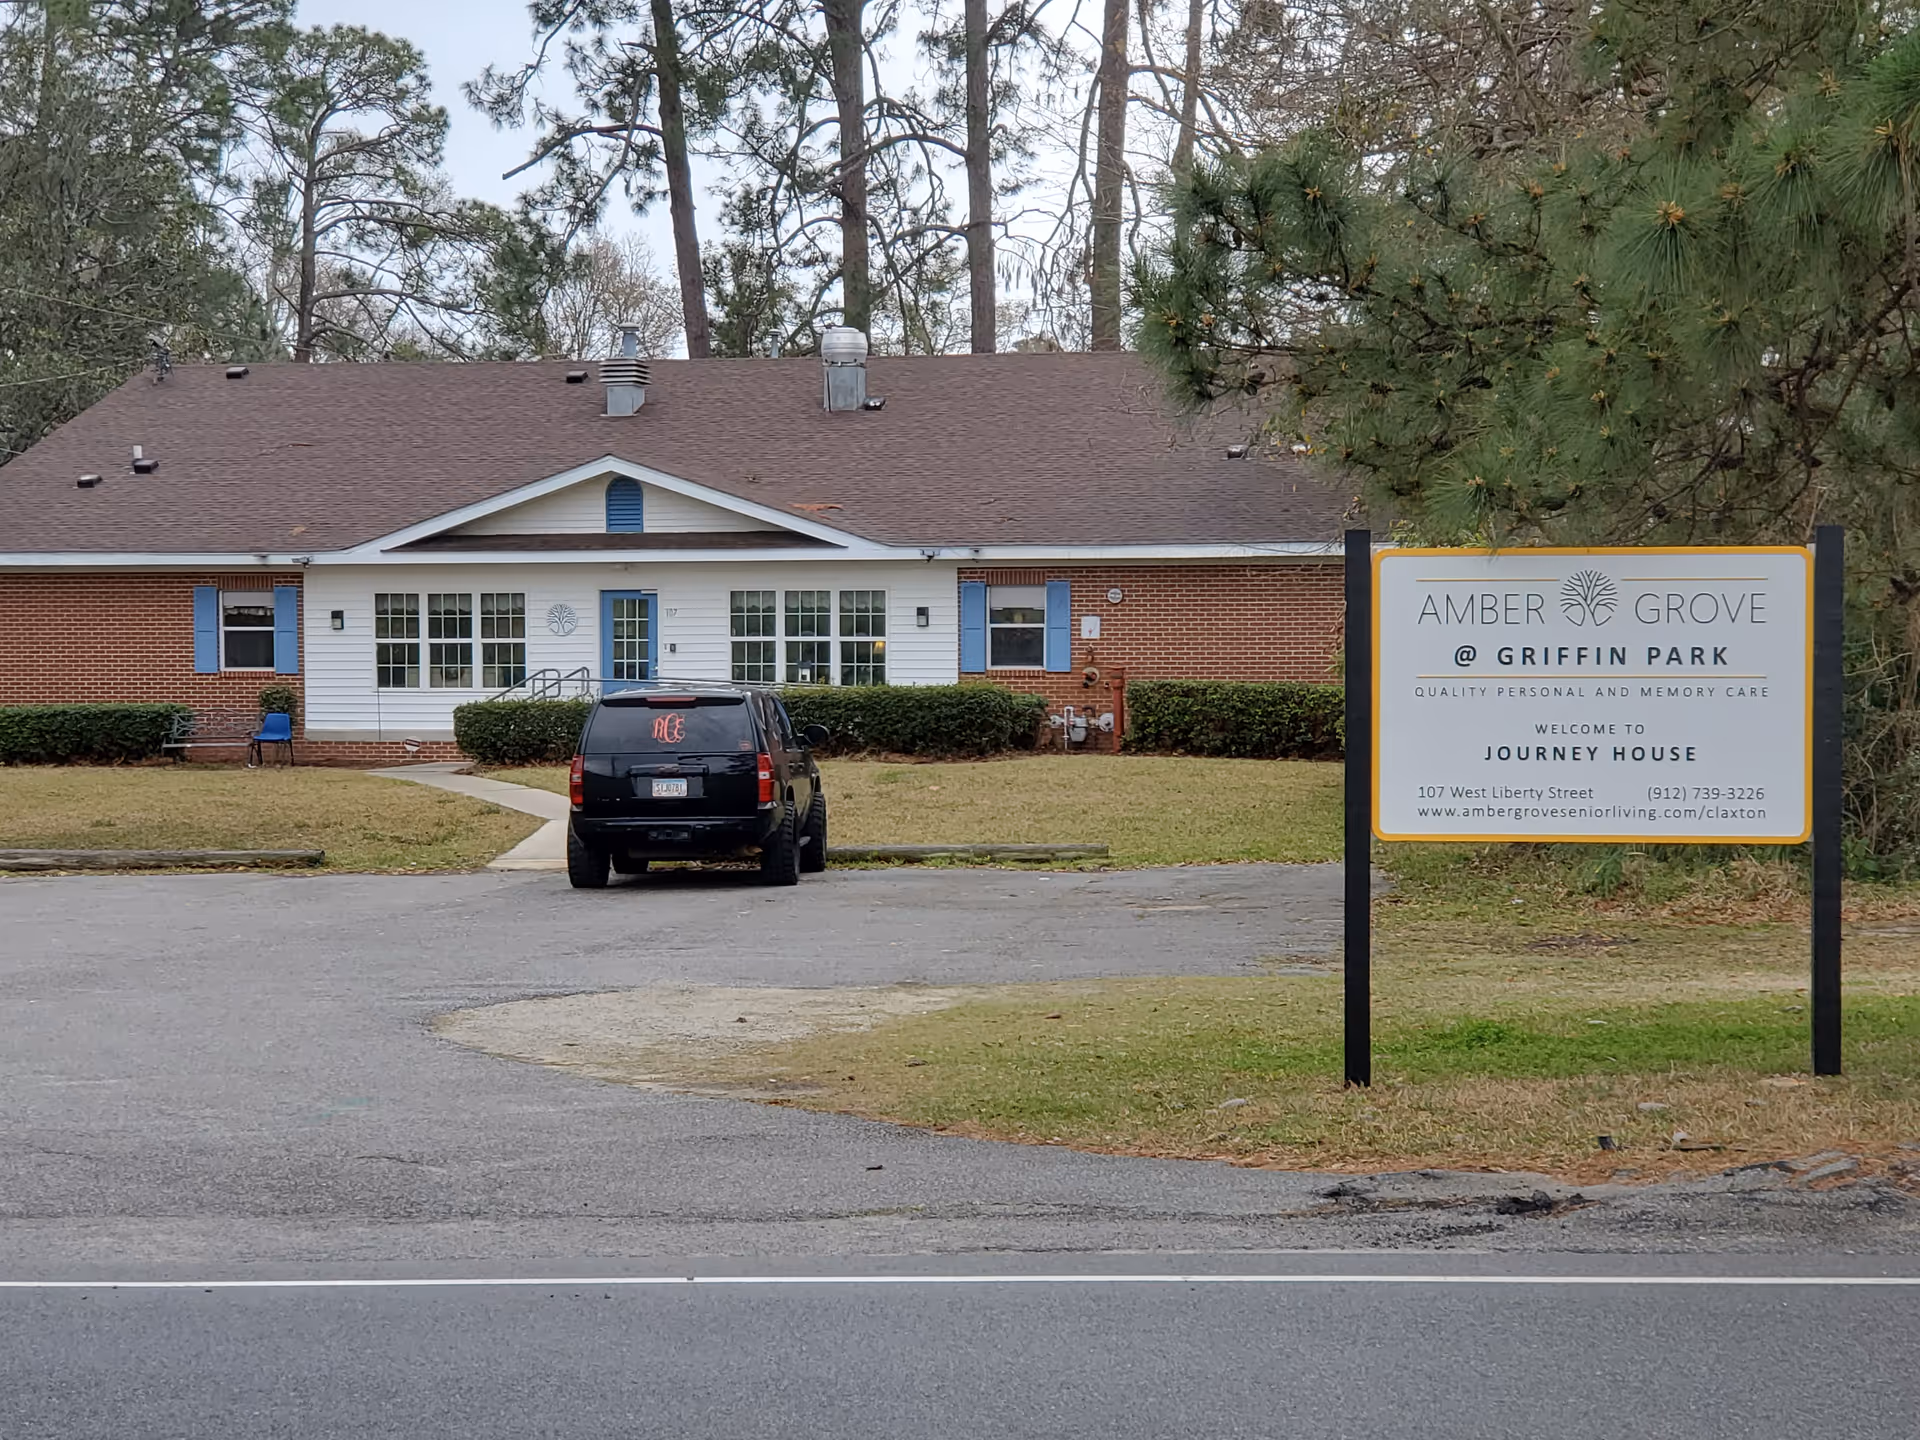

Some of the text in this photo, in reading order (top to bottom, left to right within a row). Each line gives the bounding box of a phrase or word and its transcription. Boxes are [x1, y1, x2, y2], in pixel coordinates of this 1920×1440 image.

[1417, 592, 1767, 625] AMBER GROVE
[1454, 644, 1728, 667] @ GRIFFIN PARK
[1414, 686, 1769, 699] QUALITY PERSONAL AND MEMORY CARE
[1535, 723, 1645, 735] WELCOME TO
[1484, 745, 1697, 762] JOURNEY HOUSE
[1418, 785, 1594, 802] 107 West Liberty Street
[1647, 785, 1765, 803] (912) 739-3226
[1417, 804, 1767, 822] www.ambergroveseniorliving.com/claxton
